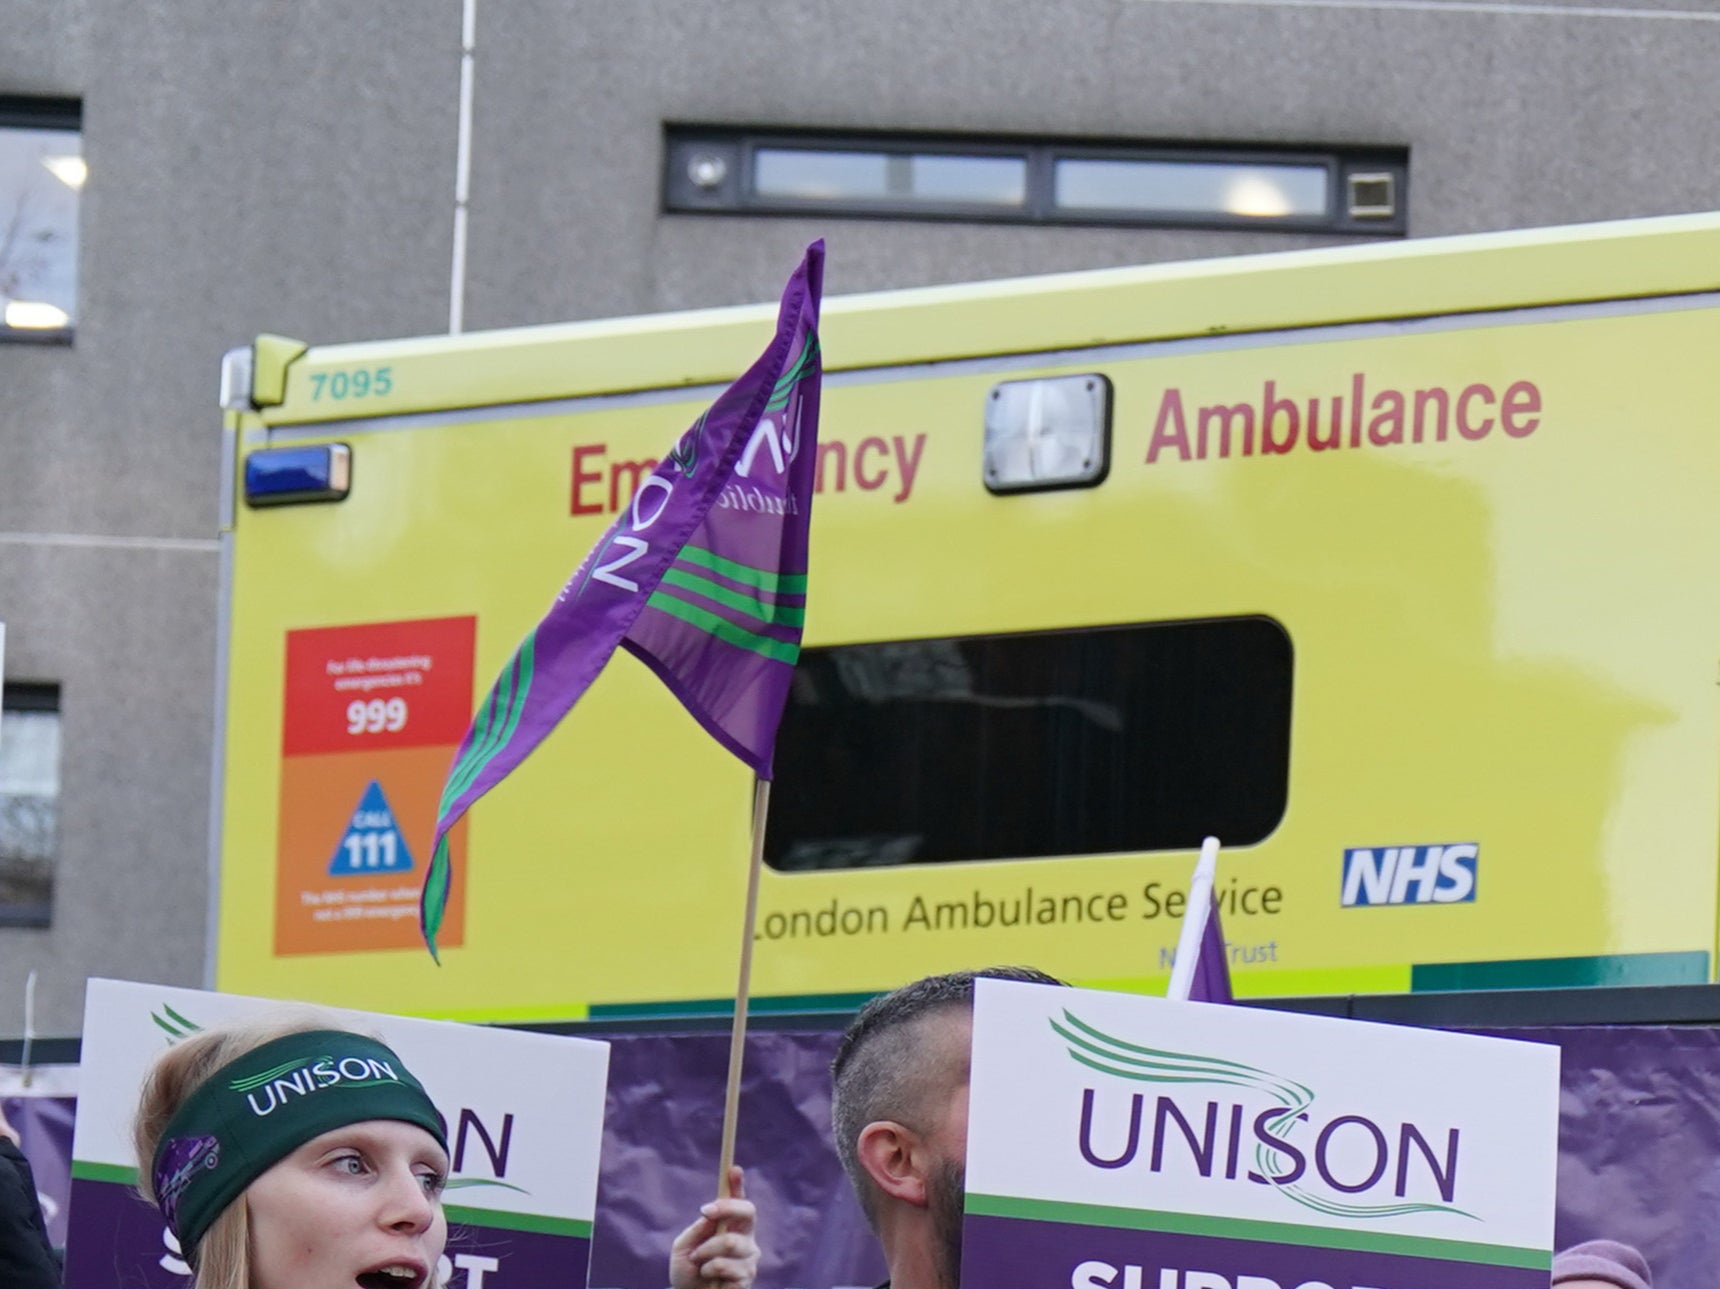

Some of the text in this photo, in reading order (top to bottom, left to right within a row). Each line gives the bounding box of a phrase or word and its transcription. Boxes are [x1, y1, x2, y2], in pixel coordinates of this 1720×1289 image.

[309, 366, 393, 401] 7095
[570, 432, 927, 517] Emncy
[1144, 373, 1541, 465] Ambulance
[346, 696, 408, 735] 999
[344, 830, 398, 868] 111
[352, 810, 392, 830] CALL
[1343, 846, 1477, 905] NHS
[753, 881, 1283, 941] ondon Ambulance Sevice
[247, 1057, 399, 1118] UNISON
[1079, 1088, 1460, 1203] UNISON
